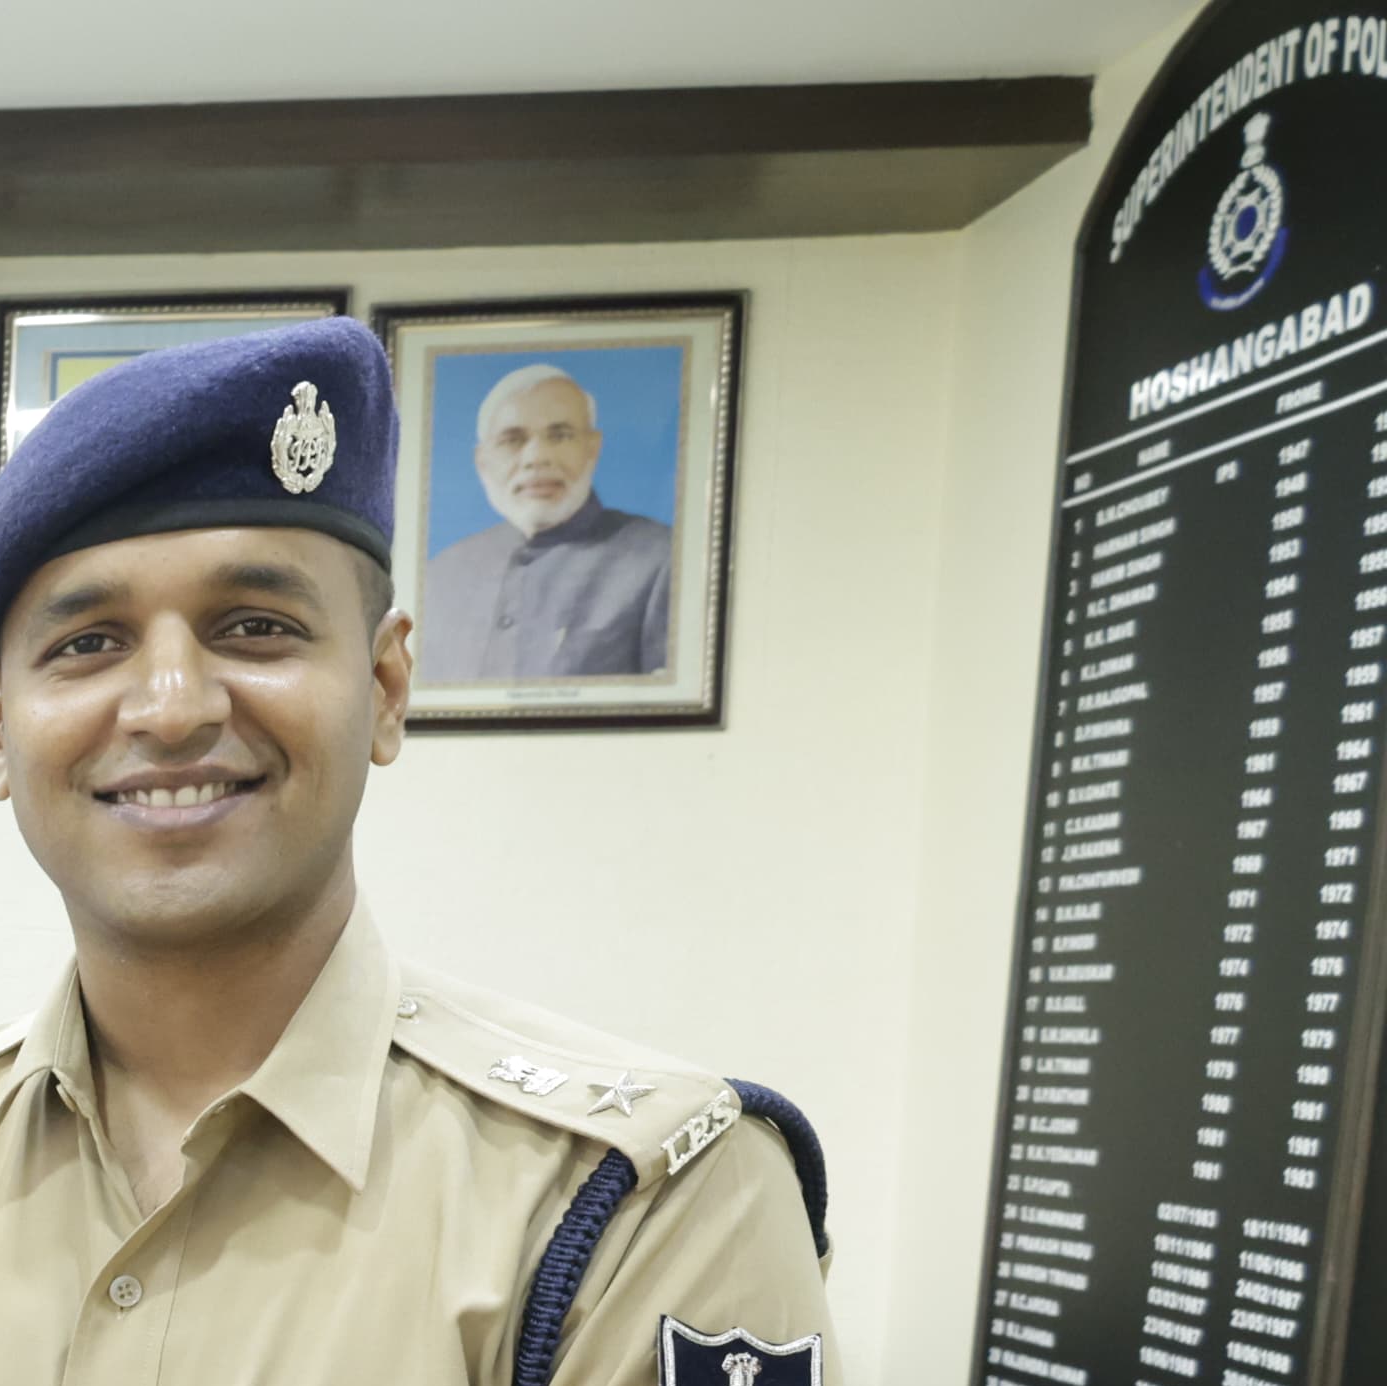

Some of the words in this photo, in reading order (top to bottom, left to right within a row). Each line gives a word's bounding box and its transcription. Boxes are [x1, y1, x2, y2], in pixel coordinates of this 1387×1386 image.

[1110, 27, 1301, 264] SUPERINTENDENT
[1304, 18, 1339, 79] OF
[1343, 15, 1387, 77] POL
[1129, 283, 1373, 421] HOSHANGABAD
[1278, 439, 1311, 465] 1947
[1275, 472, 1308, 498] 1948
[1265, 574, 1298, 598] 1954
[1350, 625, 1385, 649] 1957
[1253, 681, 1285, 703] 1957
[1341, 701, 1375, 723] 1961
[1245, 752, 1275, 773] 1961
[1336, 738, 1371, 760] 1964
[1241, 788, 1272, 808] 1964
[1333, 771, 1368, 793] 1967
[1237, 819, 1268, 839] 1967
[1325, 846, 1358, 867] 1971
[1228, 889, 1257, 908] 1971
[1320, 883, 1354, 903] 1972
[1224, 924, 1254, 943] 1972
[1315, 920, 1350, 940] 1974
[1219, 958, 1249, 976] 1974
[1306, 993, 1340, 1012] 1977
[1210, 1026, 1241, 1045] 1977
[1301, 1029, 1335, 1049] 1979
[1206, 1060, 1236, 1080] 1979
[1292, 1100, 1325, 1121] 1981
[1197, 1127, 1226, 1147] 1981
[1287, 1136, 1320, 1157] 1981
[1193, 1161, 1222, 1180] 1981
[1283, 1167, 1316, 1189] 1983
